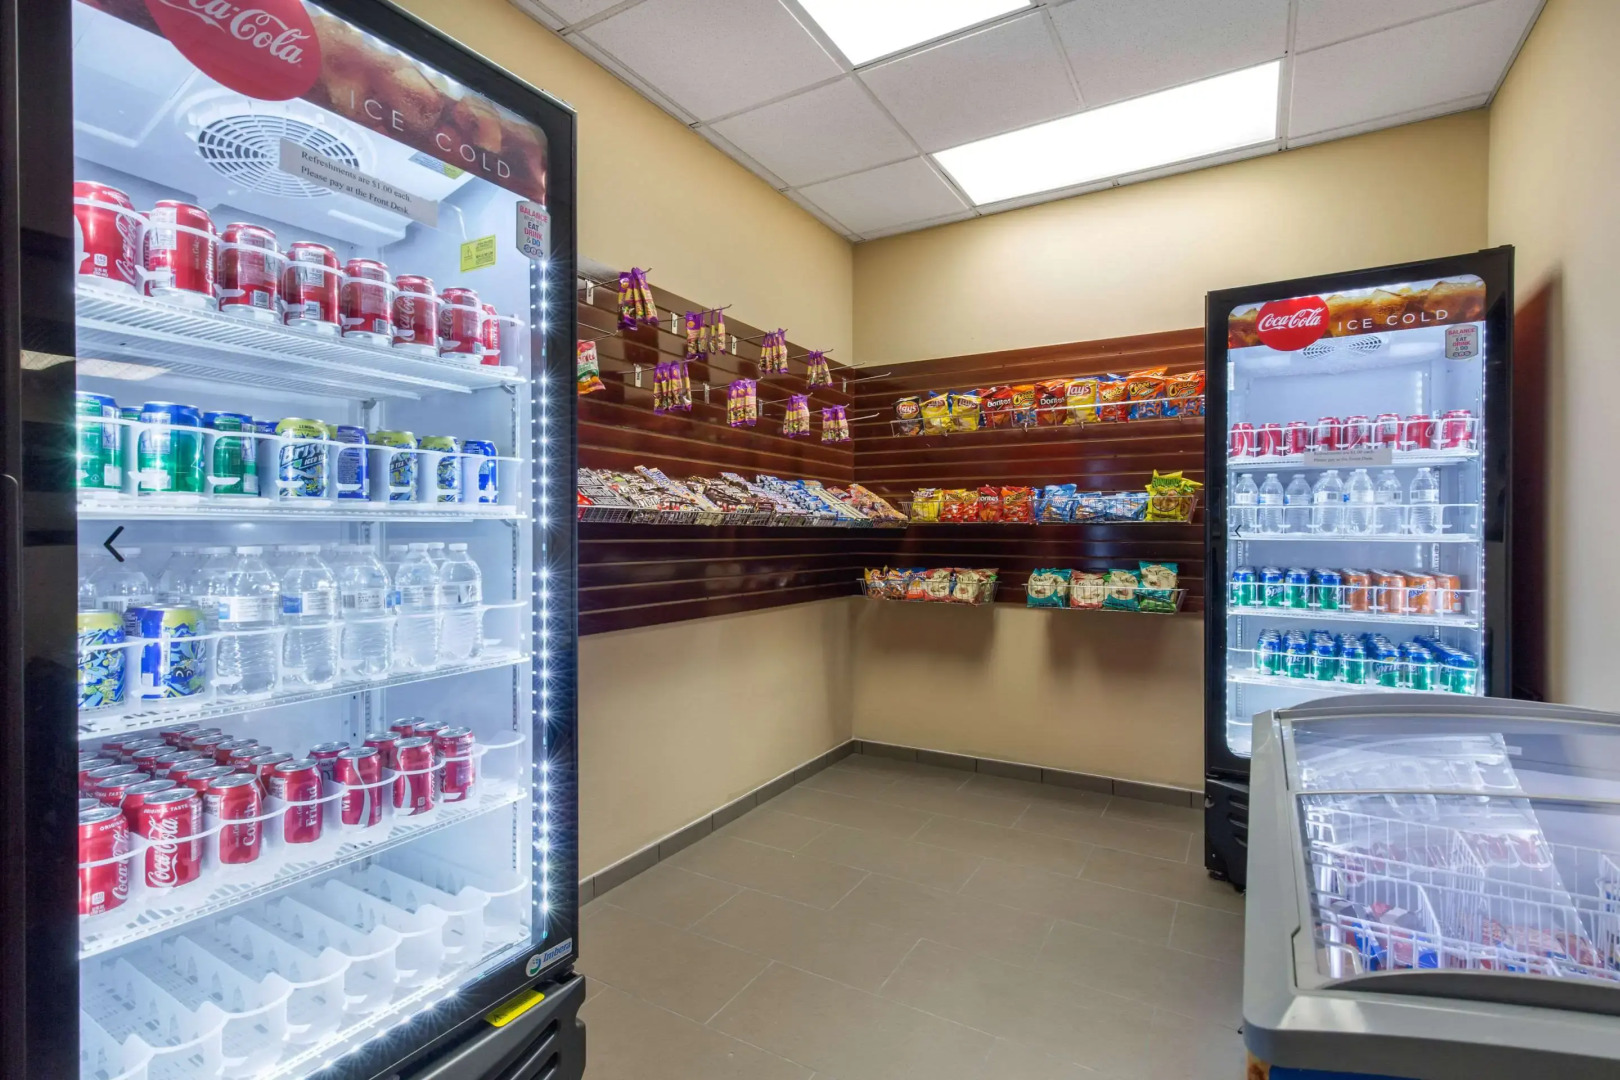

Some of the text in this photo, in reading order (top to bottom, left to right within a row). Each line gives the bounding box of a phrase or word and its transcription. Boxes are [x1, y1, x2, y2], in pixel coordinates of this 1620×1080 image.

[351, 89, 404, 132] ICE
[435, 132, 511, 179] COLD
[301, 150, 357, 180] Refreshments
[358, 176, 370, 185] are
[371, 179, 393, 194] $1.00
[301, 165, 328, 183] Please
[329, 176, 344, 190] pay
[346, 184, 354, 193] at
[355, 187, 367, 198] the
[368, 193, 389, 207] Front
[519, 204, 548, 223] BALANCE
[527, 221, 539, 232] EAT
[524, 227, 543, 241] DRINK
[531, 239, 541, 247] DO
[1258, 306, 1326, 332] Coca-Cola
[1338, 309, 1448, 332] ICE COLD
[1448, 327, 1476, 336] BALANCE
[987, 397, 1011, 408] Doritos
[1040, 396, 1065, 406] Doritos
[170, 804, 188, 812] TASTE
